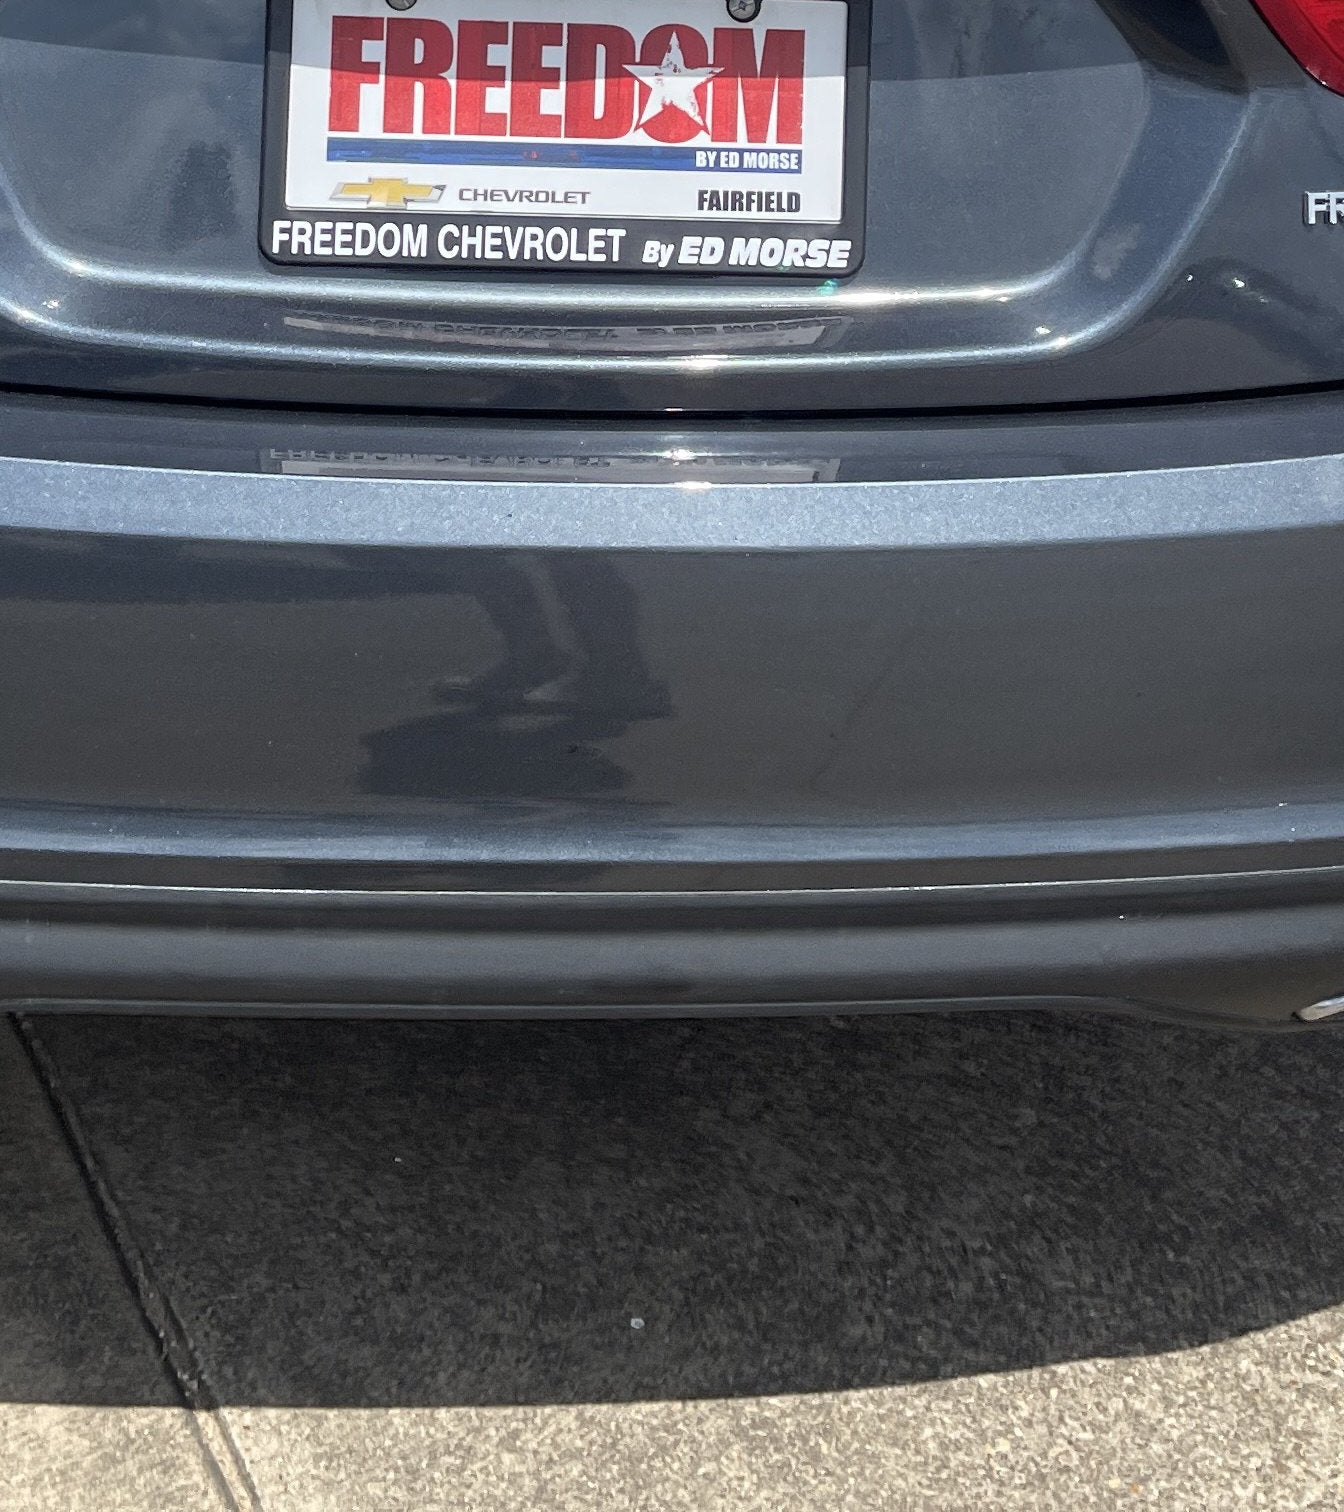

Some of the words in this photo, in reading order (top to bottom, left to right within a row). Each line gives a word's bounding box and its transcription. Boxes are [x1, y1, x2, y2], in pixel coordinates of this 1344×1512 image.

[327, 15, 805, 145] FREEDOM
[695, 150, 717, 168] BY
[720, 151, 740, 168] ED
[743, 152, 799, 170] MORSE
[458, 188, 591, 205] CHEVROLET
[697, 189, 801, 213] FAIRFIELD
[272, 220, 427, 258] FREEDOM
[437, 224, 627, 262] CHEVROLET
[677, 236, 725, 265] ED
[728, 237, 853, 268] MORSE
